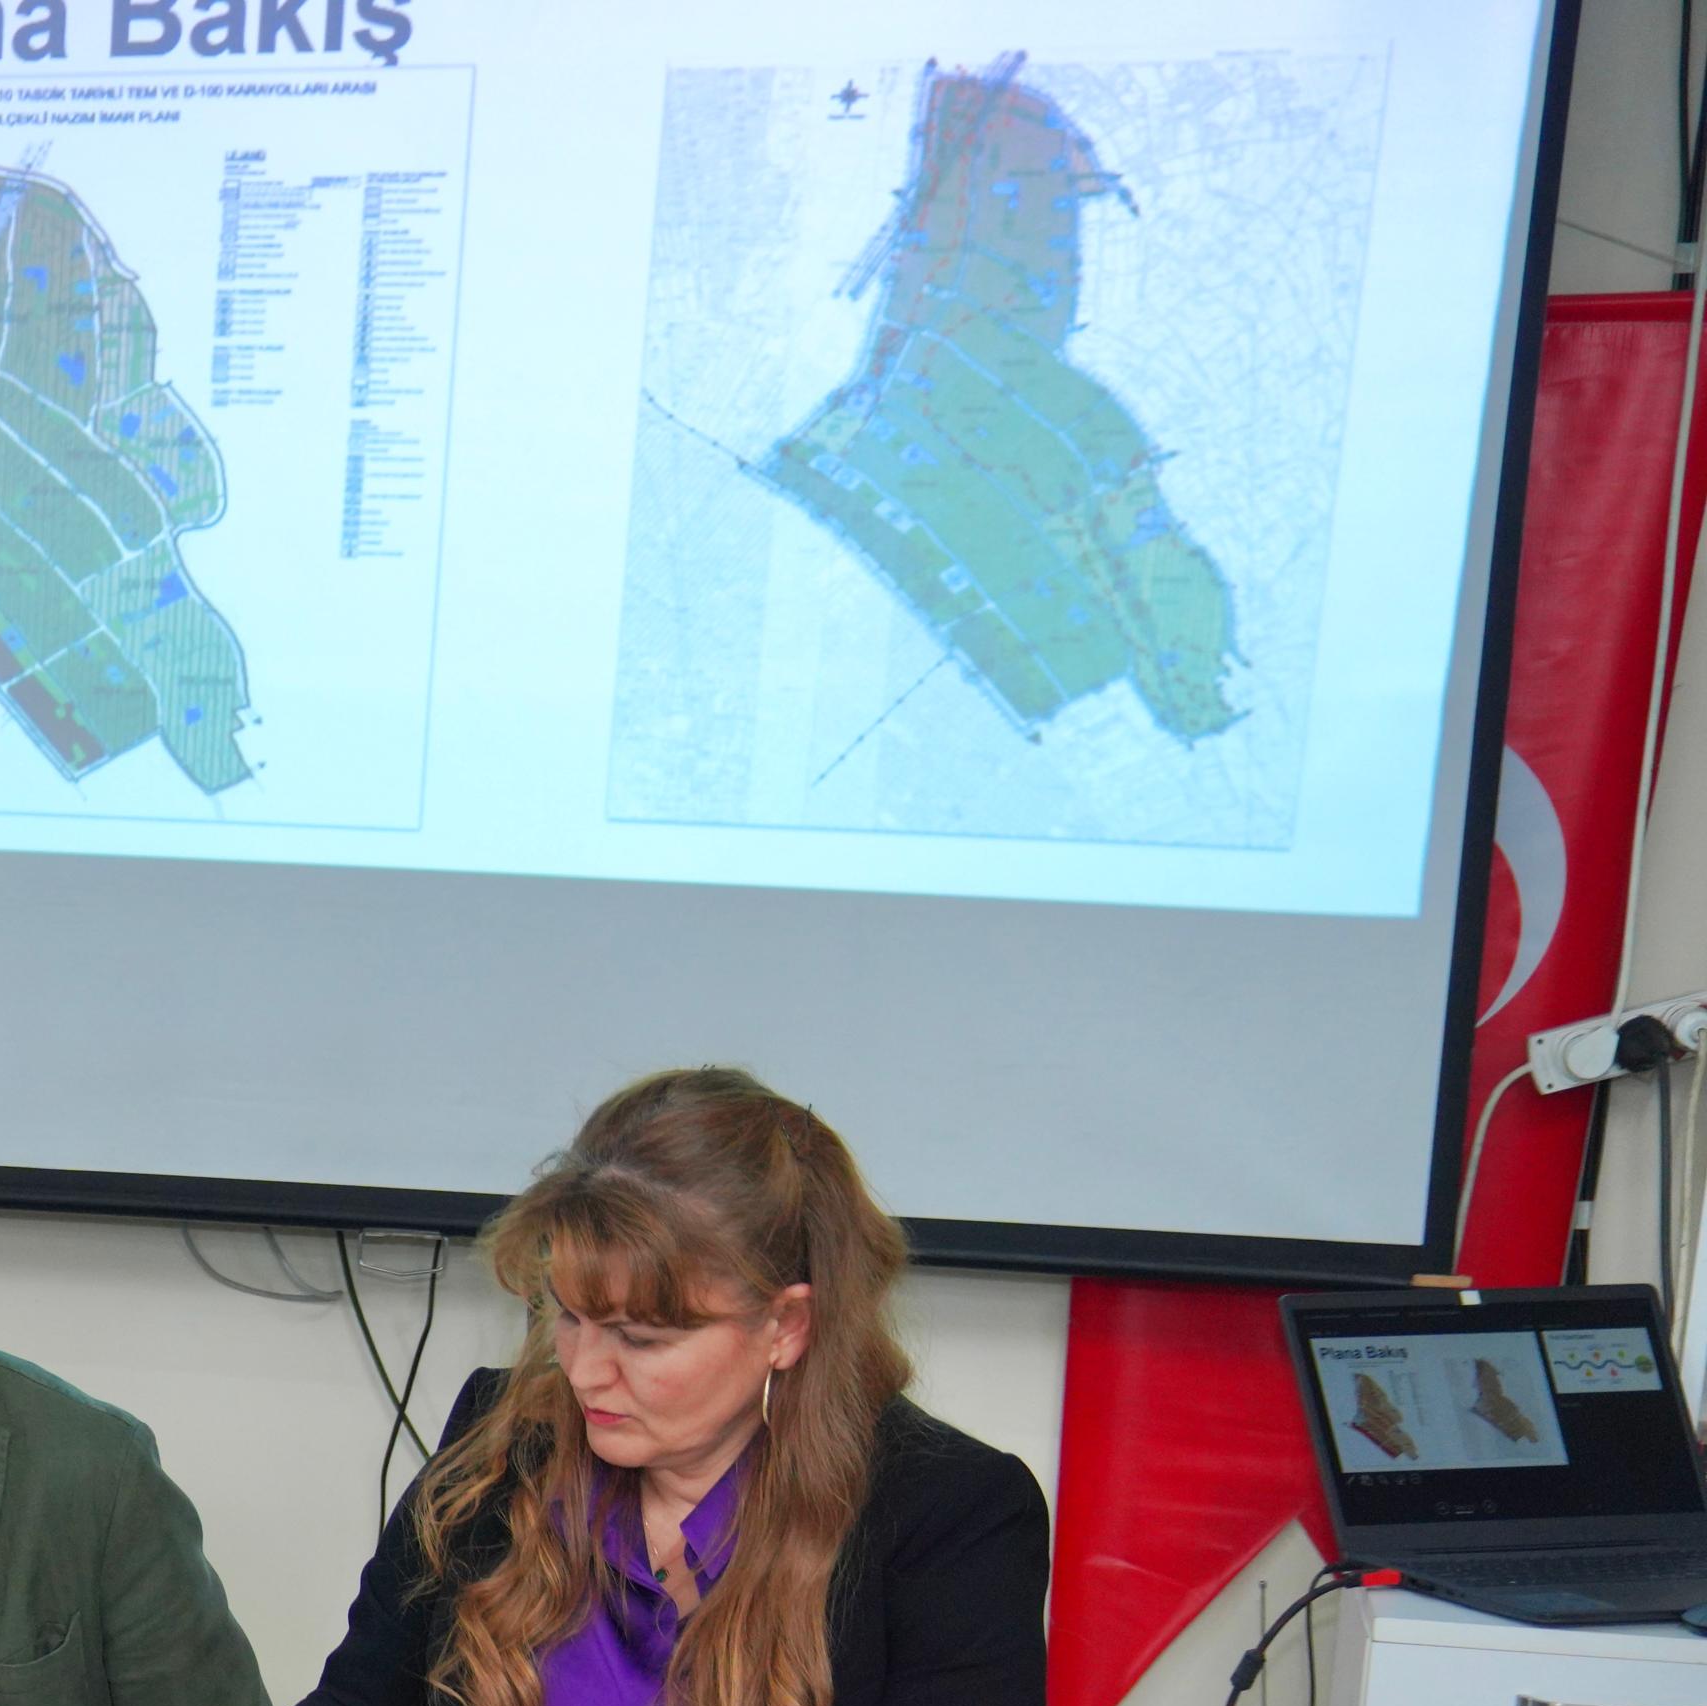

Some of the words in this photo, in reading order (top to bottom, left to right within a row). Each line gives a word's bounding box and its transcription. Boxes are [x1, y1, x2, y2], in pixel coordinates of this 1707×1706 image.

[109, 0, 412, 67] Bakış
[127, 86, 157, 99] TEM
[161, 85, 179, 98] VE
[184, 84, 224, 98] D-100
[227, 82, 328, 97] KARAYOLLARI
[330, 81, 377, 95] ARASI
[137, 111, 181, 123] PLANI
[1320, 1346, 1362, 1360] Plana
